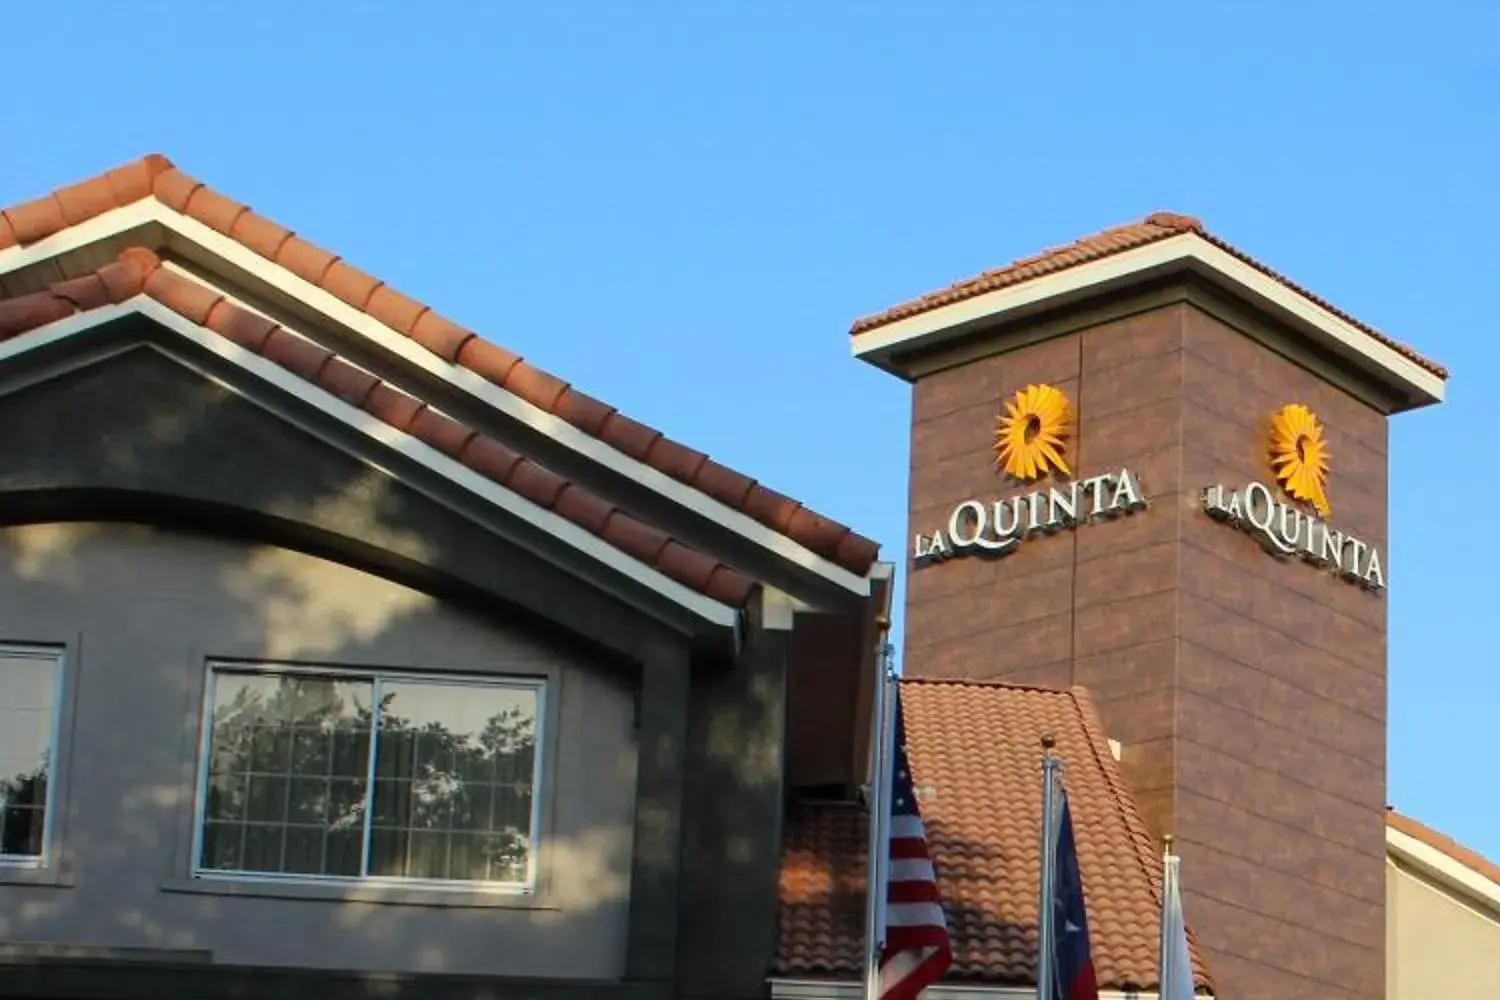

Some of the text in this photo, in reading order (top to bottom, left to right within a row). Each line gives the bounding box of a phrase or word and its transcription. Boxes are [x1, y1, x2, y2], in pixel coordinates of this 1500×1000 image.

[914, 467, 1140, 558] LA QUINTA
[1214, 480, 1386, 588] LA QUINTA
